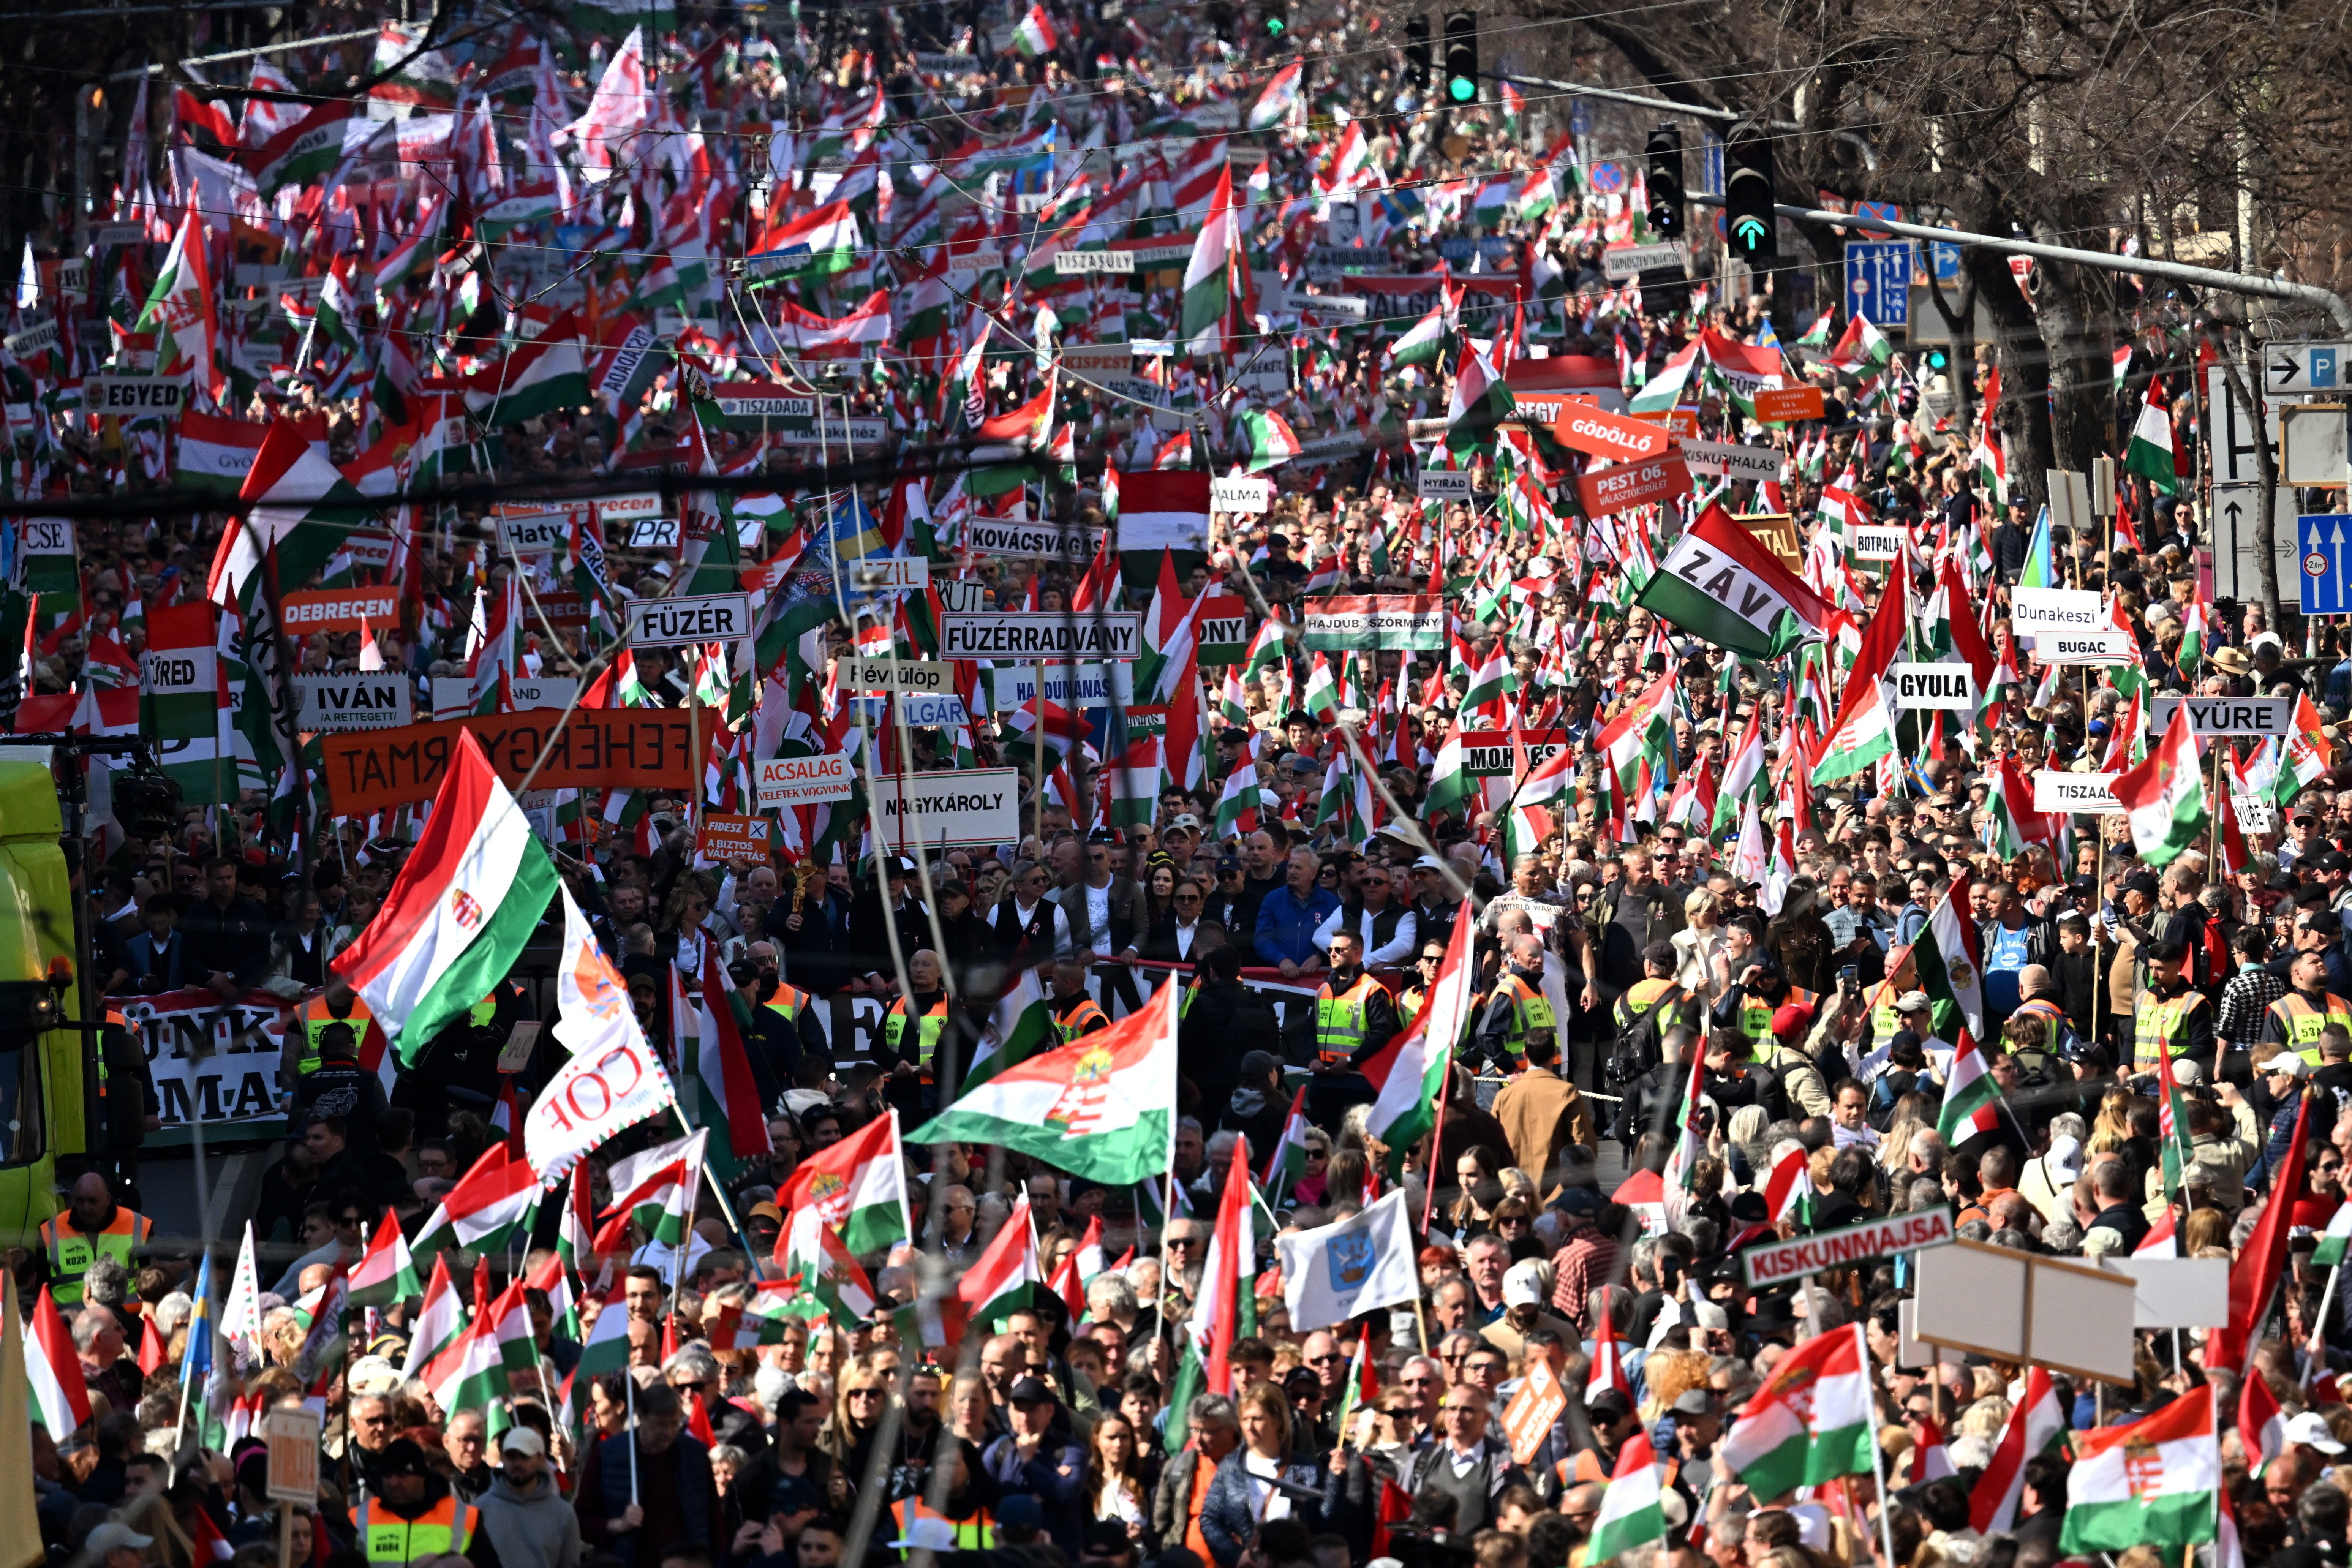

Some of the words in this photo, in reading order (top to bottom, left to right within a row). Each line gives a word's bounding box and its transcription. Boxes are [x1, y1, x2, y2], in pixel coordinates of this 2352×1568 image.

[1057, 254, 1132, 269] TISZASÜLY
[1065, 356, 1131, 369] KISPEST
[109, 385, 179, 406] EGYED
[740, 398, 808, 414] TISZADADA
[1572, 419, 1652, 451] GÖDÖLLŐ
[1683, 449, 1775, 472] KISKUNHALAS
[1424, 477, 1465, 488] NYIRÁD
[1597, 471, 1636, 494] PEST
[1599, 479, 1668, 506] VÁLASZTÓKERÜLET
[508, 522, 588, 544] Hatv
[1754, 530, 1799, 557] TAL
[1858, 534, 1899, 553] BOTPALÁ
[934, 579, 984, 612] KÚT
[284, 599, 394, 624] DEBRECEN
[526, 602, 589, 618] EBRECE
[643, 602, 733, 638] FÜZÉR
[2018, 603, 2095, 624] Dunakeszi
[948, 620, 1133, 651] FÜZÉRRADVÁNY
[2058, 641, 2106, 653] BUGAC
[147, 656, 195, 686] ÜRED
[318, 682, 396, 710] IVÁN
[1900, 675, 1968, 697] GYULA
[763, 759, 842, 782] ACSALAG
[759, 789, 800, 801] VELETEK
[802, 783, 850, 797] VAGYUNK
[2058, 785, 2120, 800] TISZAAL
[885, 792, 1003, 816] NAGYKÁROLY
[2235, 801, 2264, 827] YÜRE
[708, 822, 743, 832] FIDESZ
[716, 840, 753, 851] BIZTOS
[1500, 902, 1531, 912] WORLD
[1533, 904, 1552, 913] WAR
[1752, 1215, 1949, 1280] KISKUNMAJSA
[65, 1255, 87, 1266] K020
